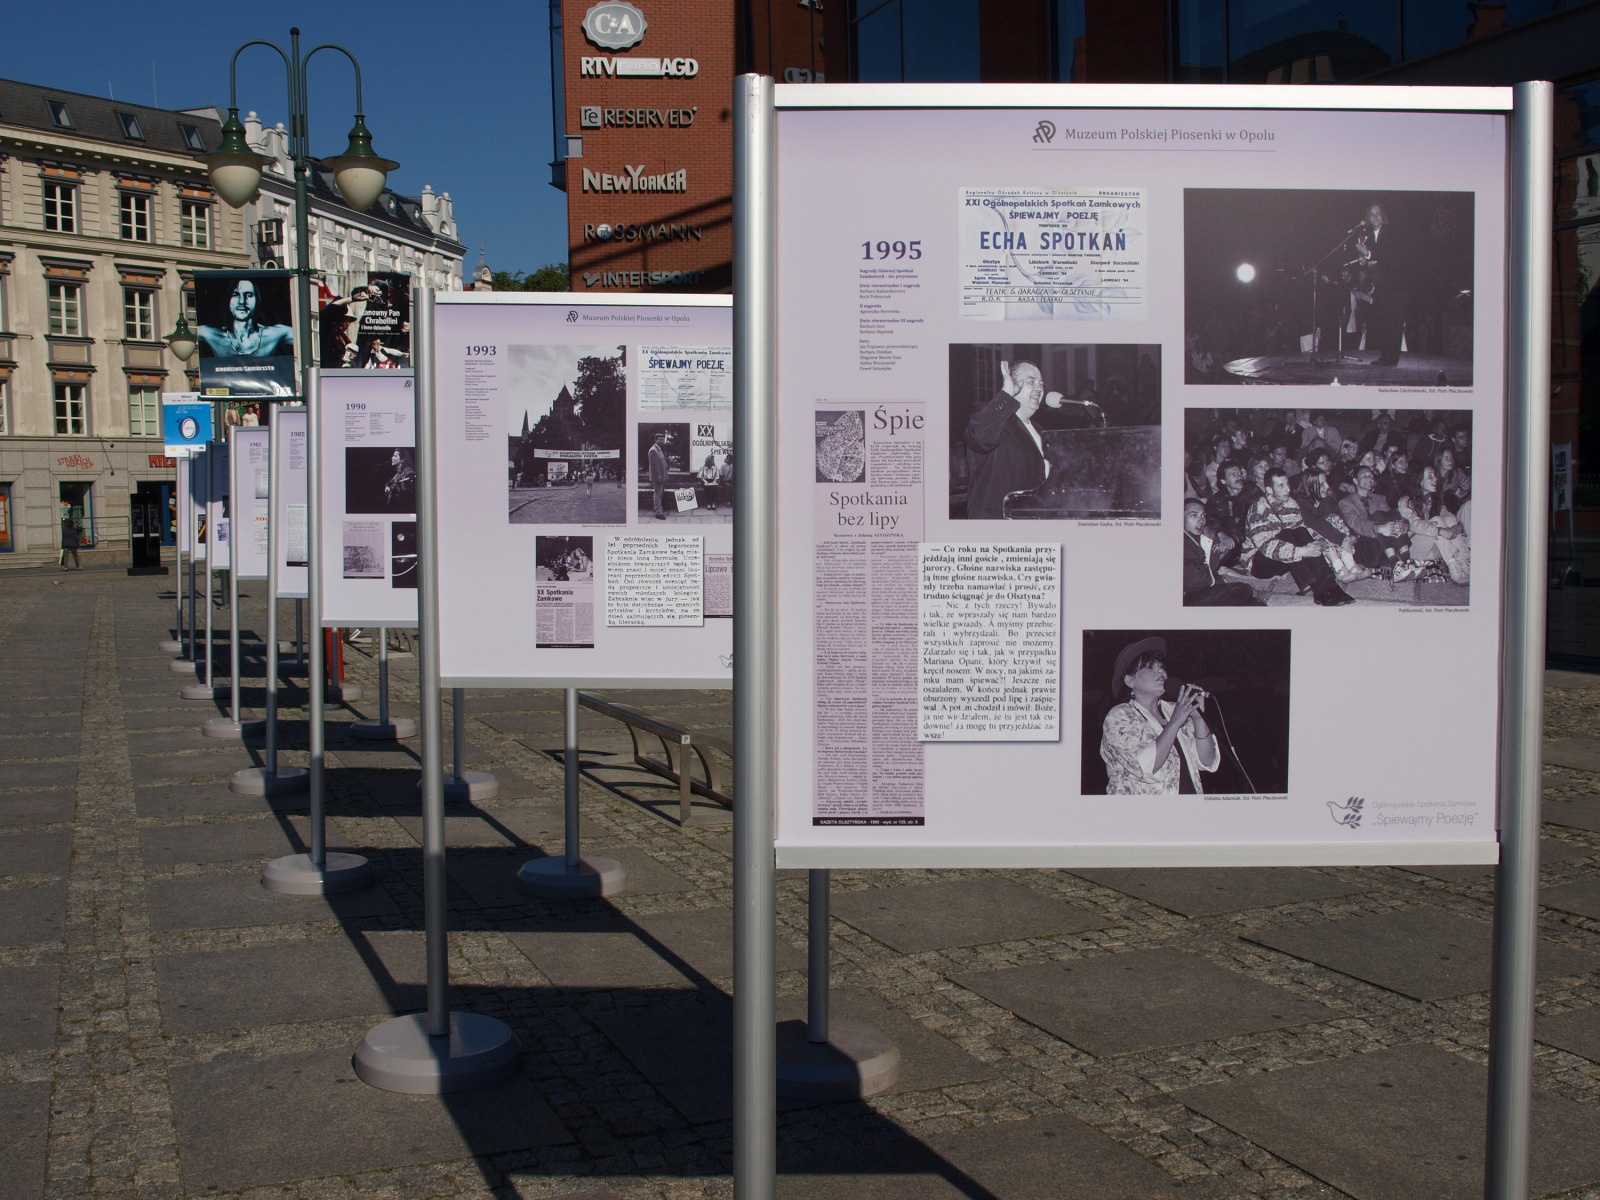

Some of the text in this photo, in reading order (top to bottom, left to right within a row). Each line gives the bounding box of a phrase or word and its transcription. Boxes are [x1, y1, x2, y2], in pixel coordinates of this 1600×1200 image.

[595, 14, 636, 34] C&A
[604, 108, 694, 126] RESERVED
[1065, 129, 1275, 143] Muzeum Polskiej Piosenki w Opolu
[983, 199, 1048, 209] Ogólnopolskich
[1051, 199, 1086, 209] Spotkań
[1089, 200, 1141, 210] Zamkowych
[1009, 211, 1099, 222] ŚPIEWAJMY POEZJĘ
[980, 229, 1126, 250] ECHA SPOTKAŃ
[861, 240, 922, 260] 1995
[603, 271, 700, 286] INTERSPORT
[583, 314, 610, 322] Muzeum
[611, 314, 635, 323] Polskiej
[636, 314, 663, 322] Piosenki
[671, 315, 690, 323] Opolu
[465, 345, 497, 356] 1993
[649, 357, 724, 371] ŚPIEWAJMY POEZJĘ
[874, 405, 924, 435] Śpie
[830, 492, 908, 509] Spotkania
[838, 512, 899, 529] bez lipy
[993, 546, 1032, 554] Spotkania
[923, 555, 955, 564] jeżdżają
[1006, 555, 1043, 564] zmieniają
[1046, 555, 1056, 564] się
[922, 564, 954, 573] jurorzy.
[1024, 564, 1055, 573] zastępu-
[952, 573, 975, 582] głośne
[924, 583, 936, 592] zdy
[952, 592, 984, 601] ściągnąć
[986, 592, 993, 601] je
[1007, 592, 1045, 601] Olsztyna?
[958, 611, 994, 620] wpraszały
[999, 611, 1008, 620] się
[959, 648, 968, 657] się
[995, 648, 1004, 657] jak
[1018, 648, 1056, 657] przypadku
